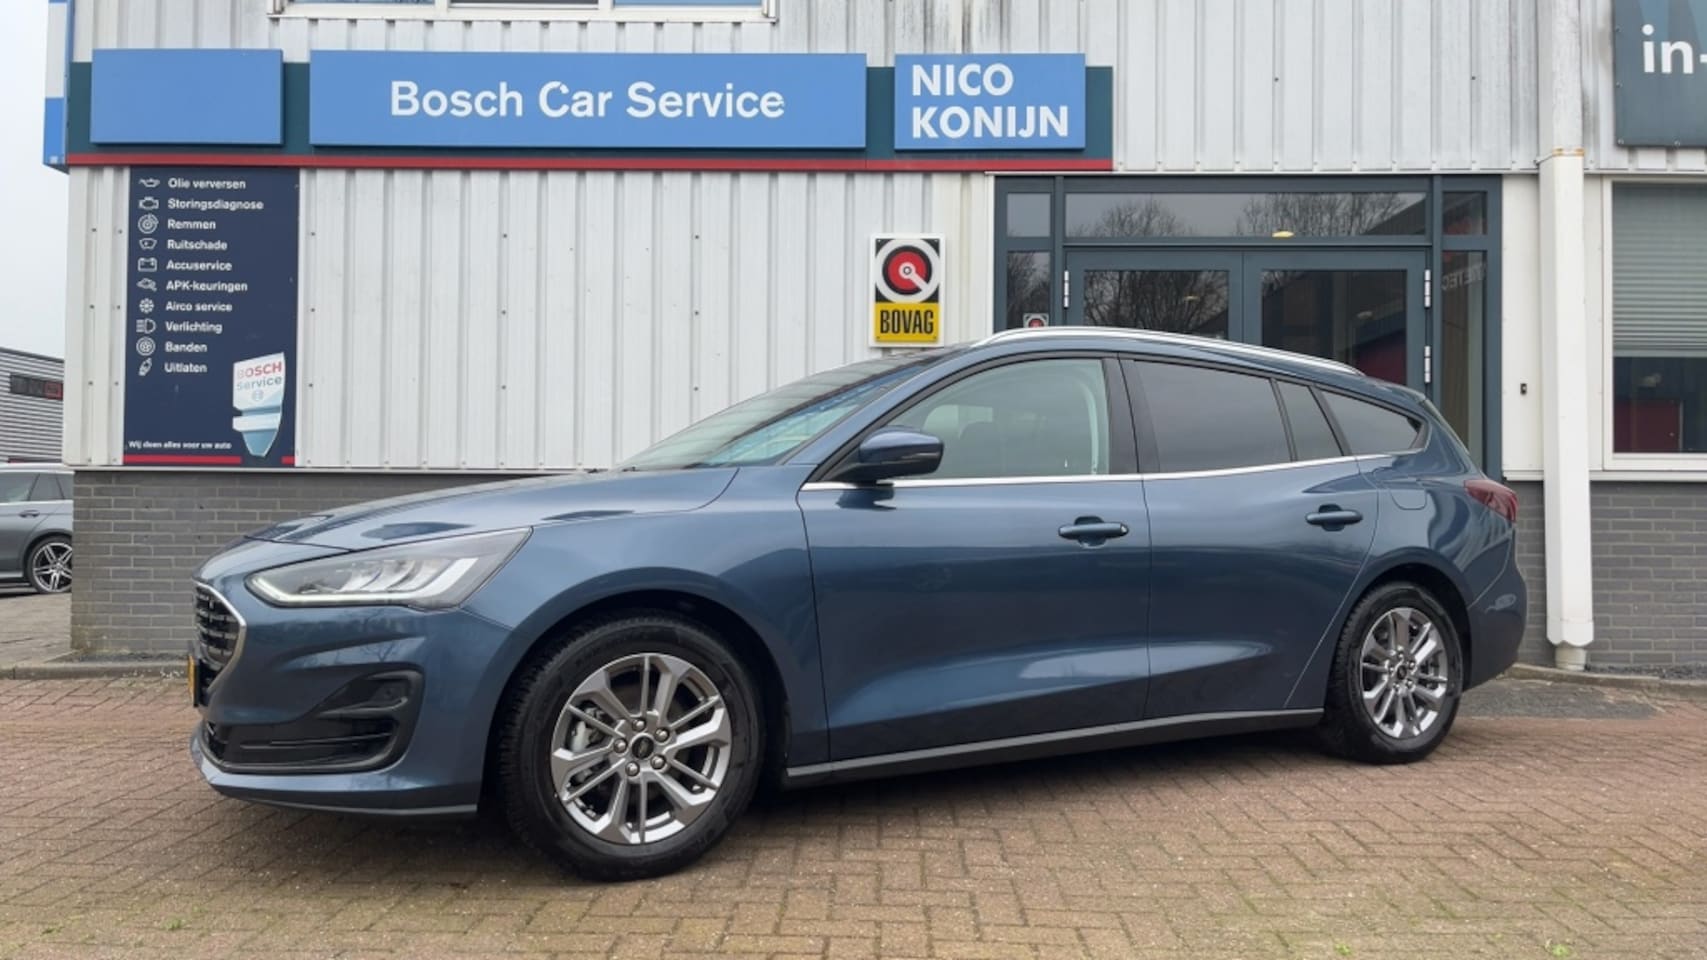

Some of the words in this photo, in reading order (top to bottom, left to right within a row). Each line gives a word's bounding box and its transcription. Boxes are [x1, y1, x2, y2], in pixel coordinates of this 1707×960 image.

[912, 63, 1014, 96] NICO
[391, 80, 524, 117] Bosch
[539, 80, 613, 118] Car
[626, 81, 785, 118] Service
[912, 106, 1068, 139] KONIJN
[168, 178, 190, 190] Olie
[193, 179, 246, 190] verversen
[167, 199, 264, 211] Storingsdiagnose
[167, 219, 216, 230] Remmen
[167, 239, 228, 251] Ruitschade
[166, 260, 232, 272] Accuservice
[166, 281, 248, 293] APK-keuringen
[165, 301, 193, 312] Airco
[195, 302, 233, 312] service
[165, 321, 223, 334] Verlichting
[880, 309, 934, 335] BOVAG
[165, 341, 208, 353] Banden
[164, 362, 208, 374] Uitlaten
[237, 361, 283, 379] BOSCH
[128, 441, 142, 449] Wij
[143, 441, 162, 449] doen
[163, 441, 181, 449] alles
[182, 441, 200, 449] voor
[201, 441, 213, 449] uw
[214, 441, 232, 449] auto
